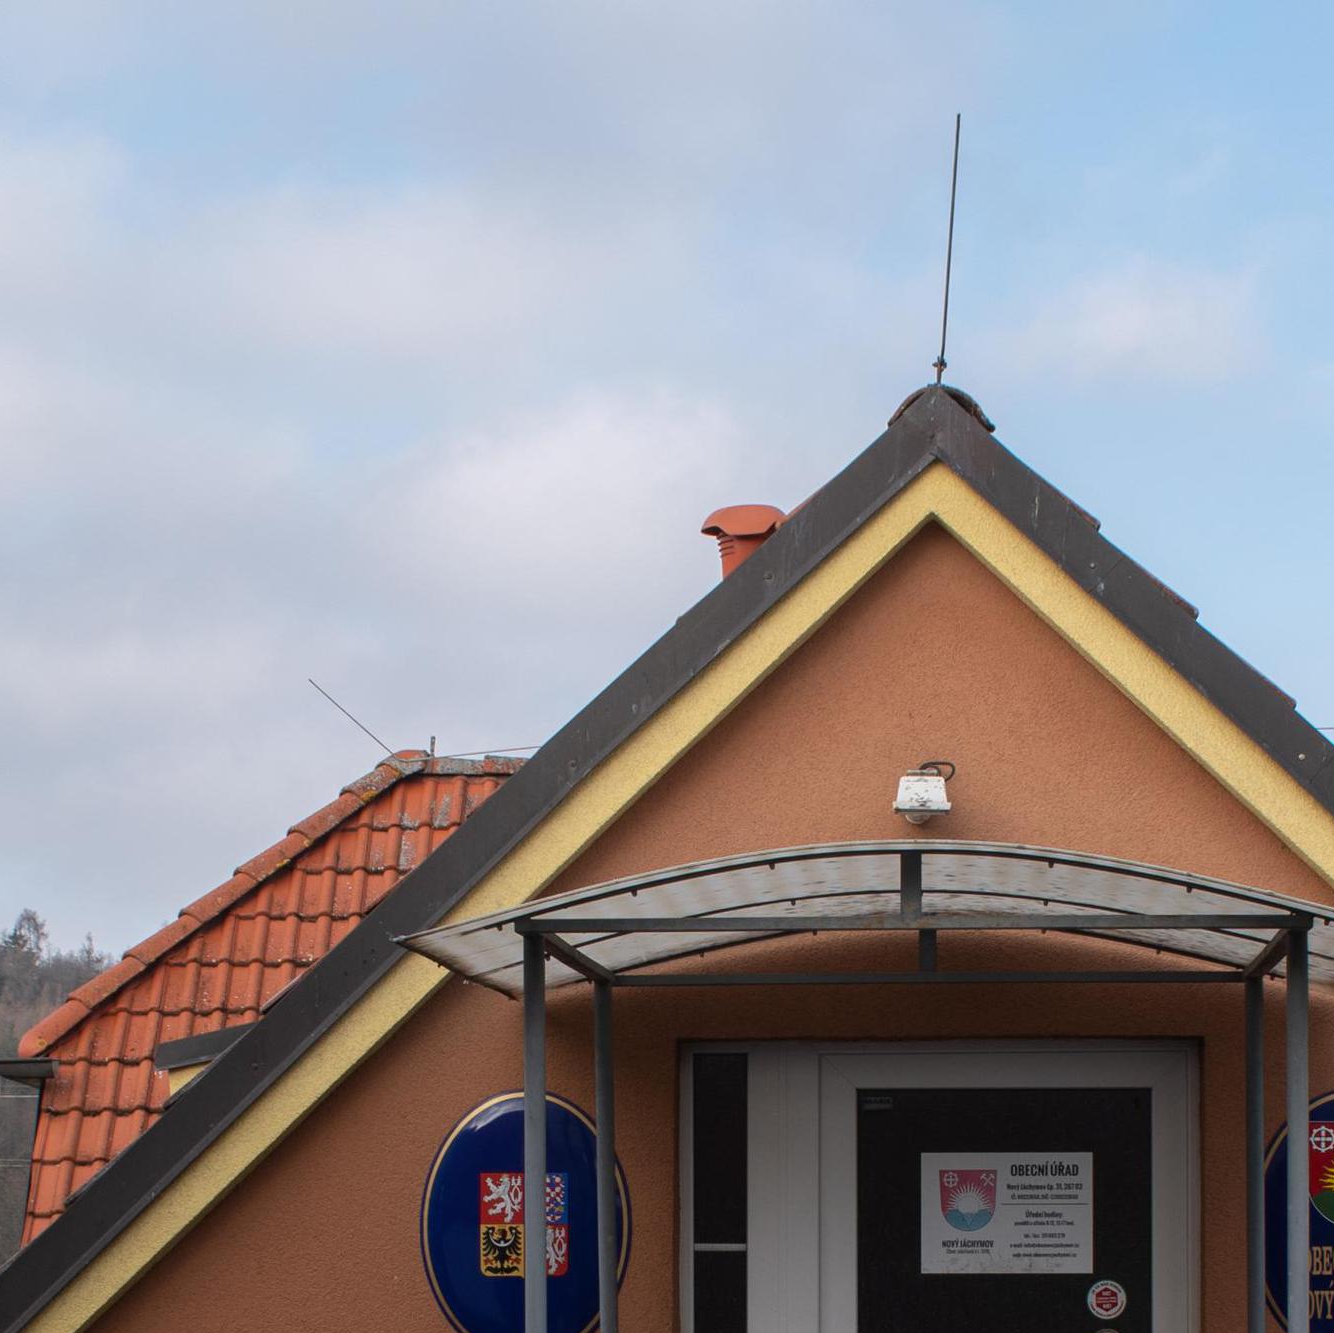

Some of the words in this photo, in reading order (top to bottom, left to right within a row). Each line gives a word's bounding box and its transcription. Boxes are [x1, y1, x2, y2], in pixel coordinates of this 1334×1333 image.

[1010, 1160, 1049, 1177] OBECNÍ
[1050, 1160, 1079, 1177] ÚŘAD
[941, 1238, 959, 1248] NOVÝ
[960, 1238, 994, 1248] JÁCHYMOV
[1308, 1280, 1334, 1320] OVÝ
